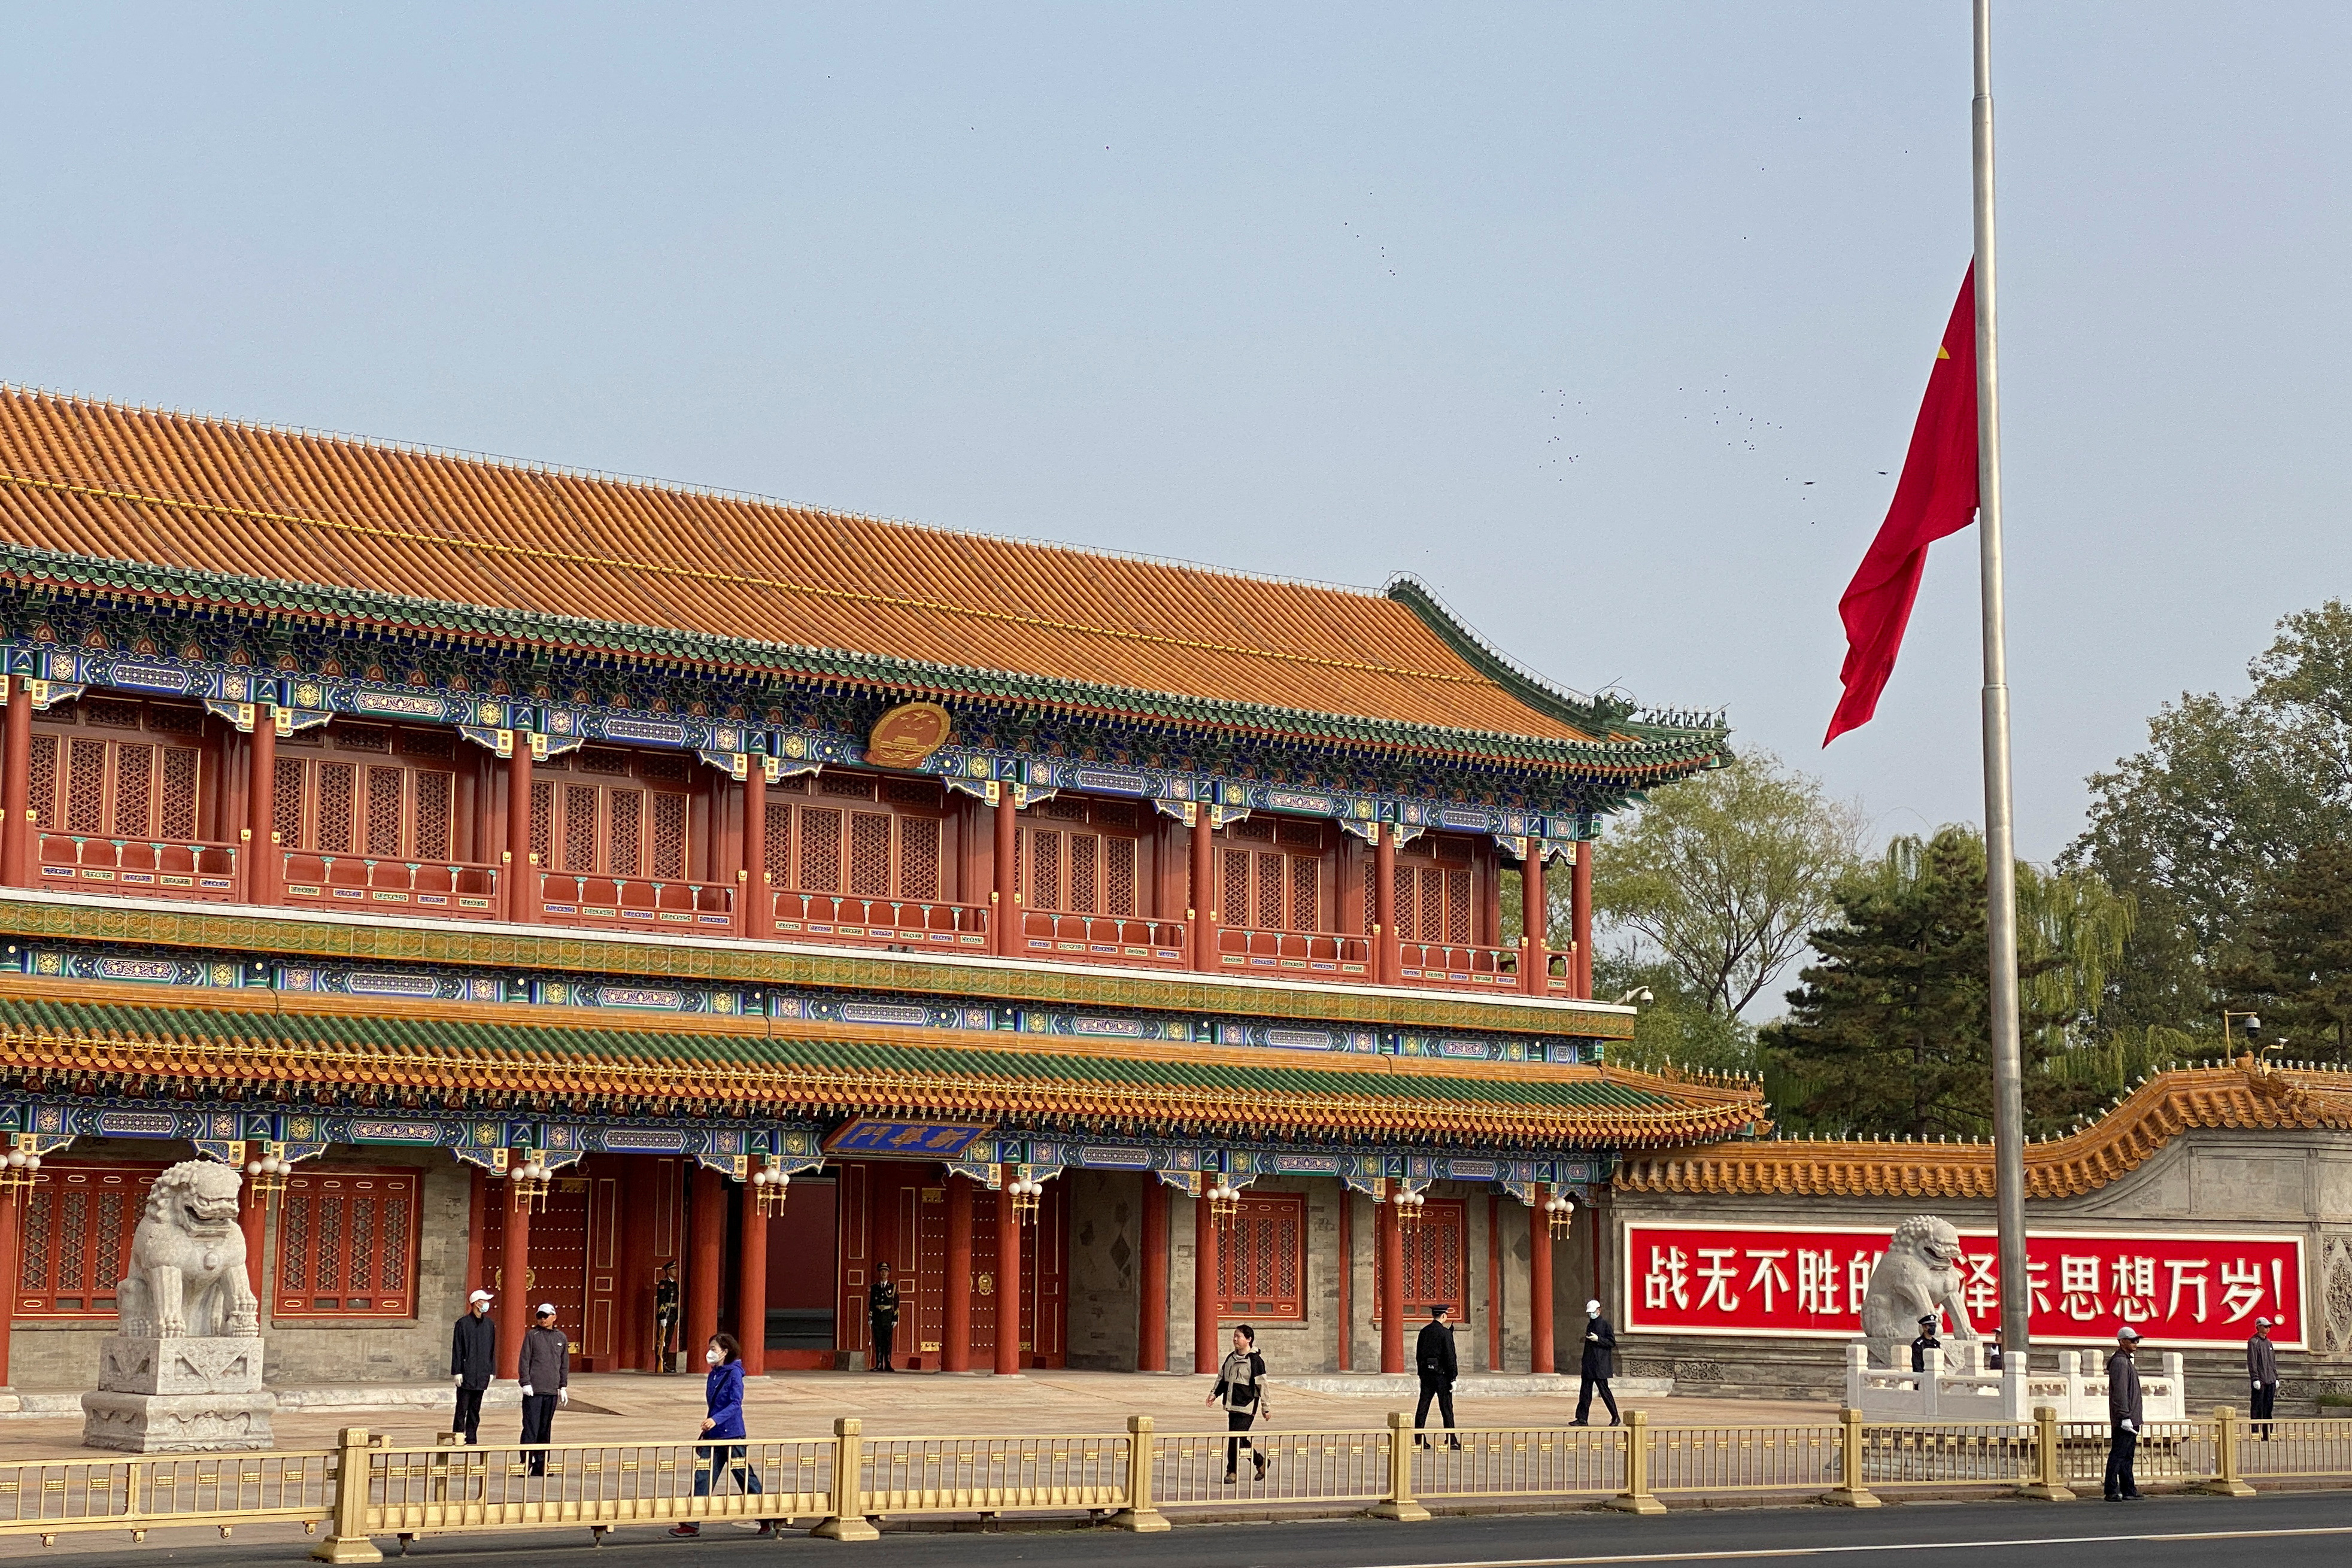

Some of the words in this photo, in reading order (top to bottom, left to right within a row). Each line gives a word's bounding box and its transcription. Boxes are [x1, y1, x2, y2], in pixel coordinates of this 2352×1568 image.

[1644, 1245, 2286, 1326] 战无不胜的泽思想万岁！
